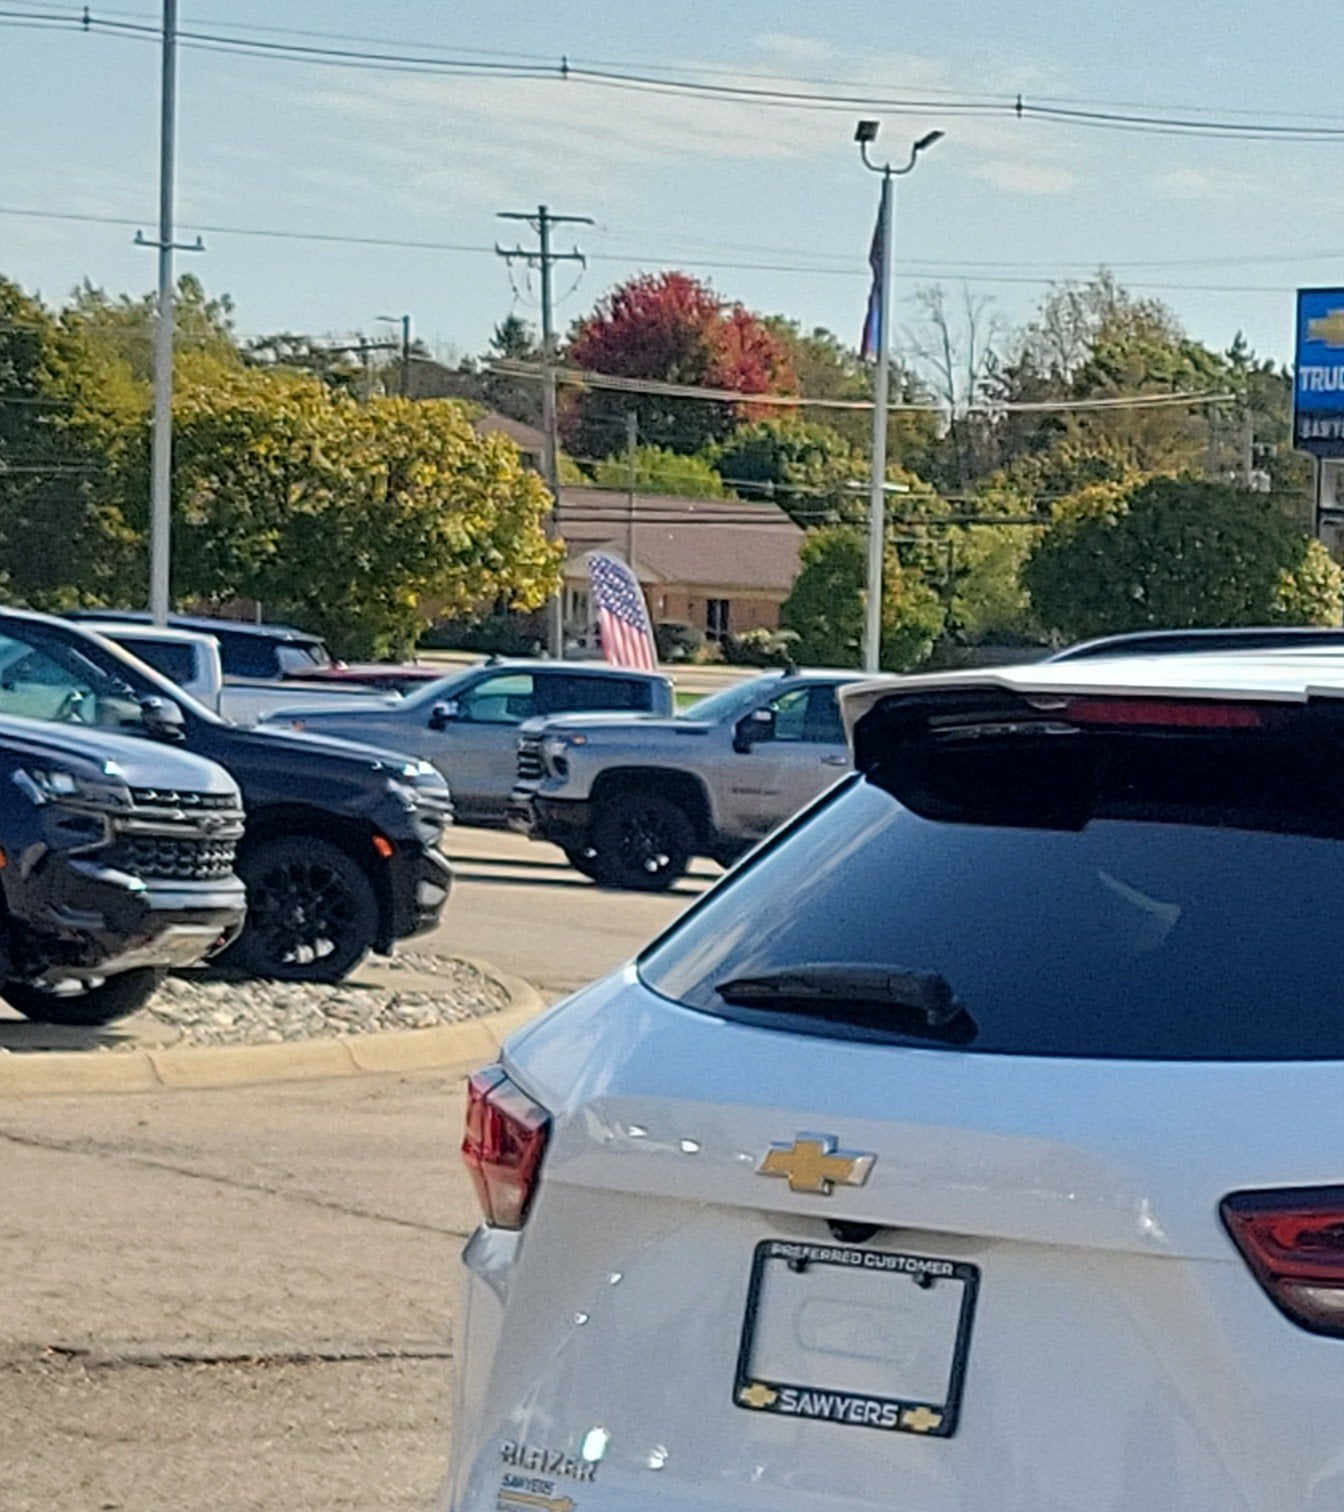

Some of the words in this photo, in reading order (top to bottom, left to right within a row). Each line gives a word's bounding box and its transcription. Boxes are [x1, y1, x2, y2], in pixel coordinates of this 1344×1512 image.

[770, 1242, 862, 1265] PREFERRED
[863, 1252, 954, 1276] CUSTOMER
[780, 1388, 899, 1427] SAWYERS
[501, 1439, 599, 1483] BLAZER
